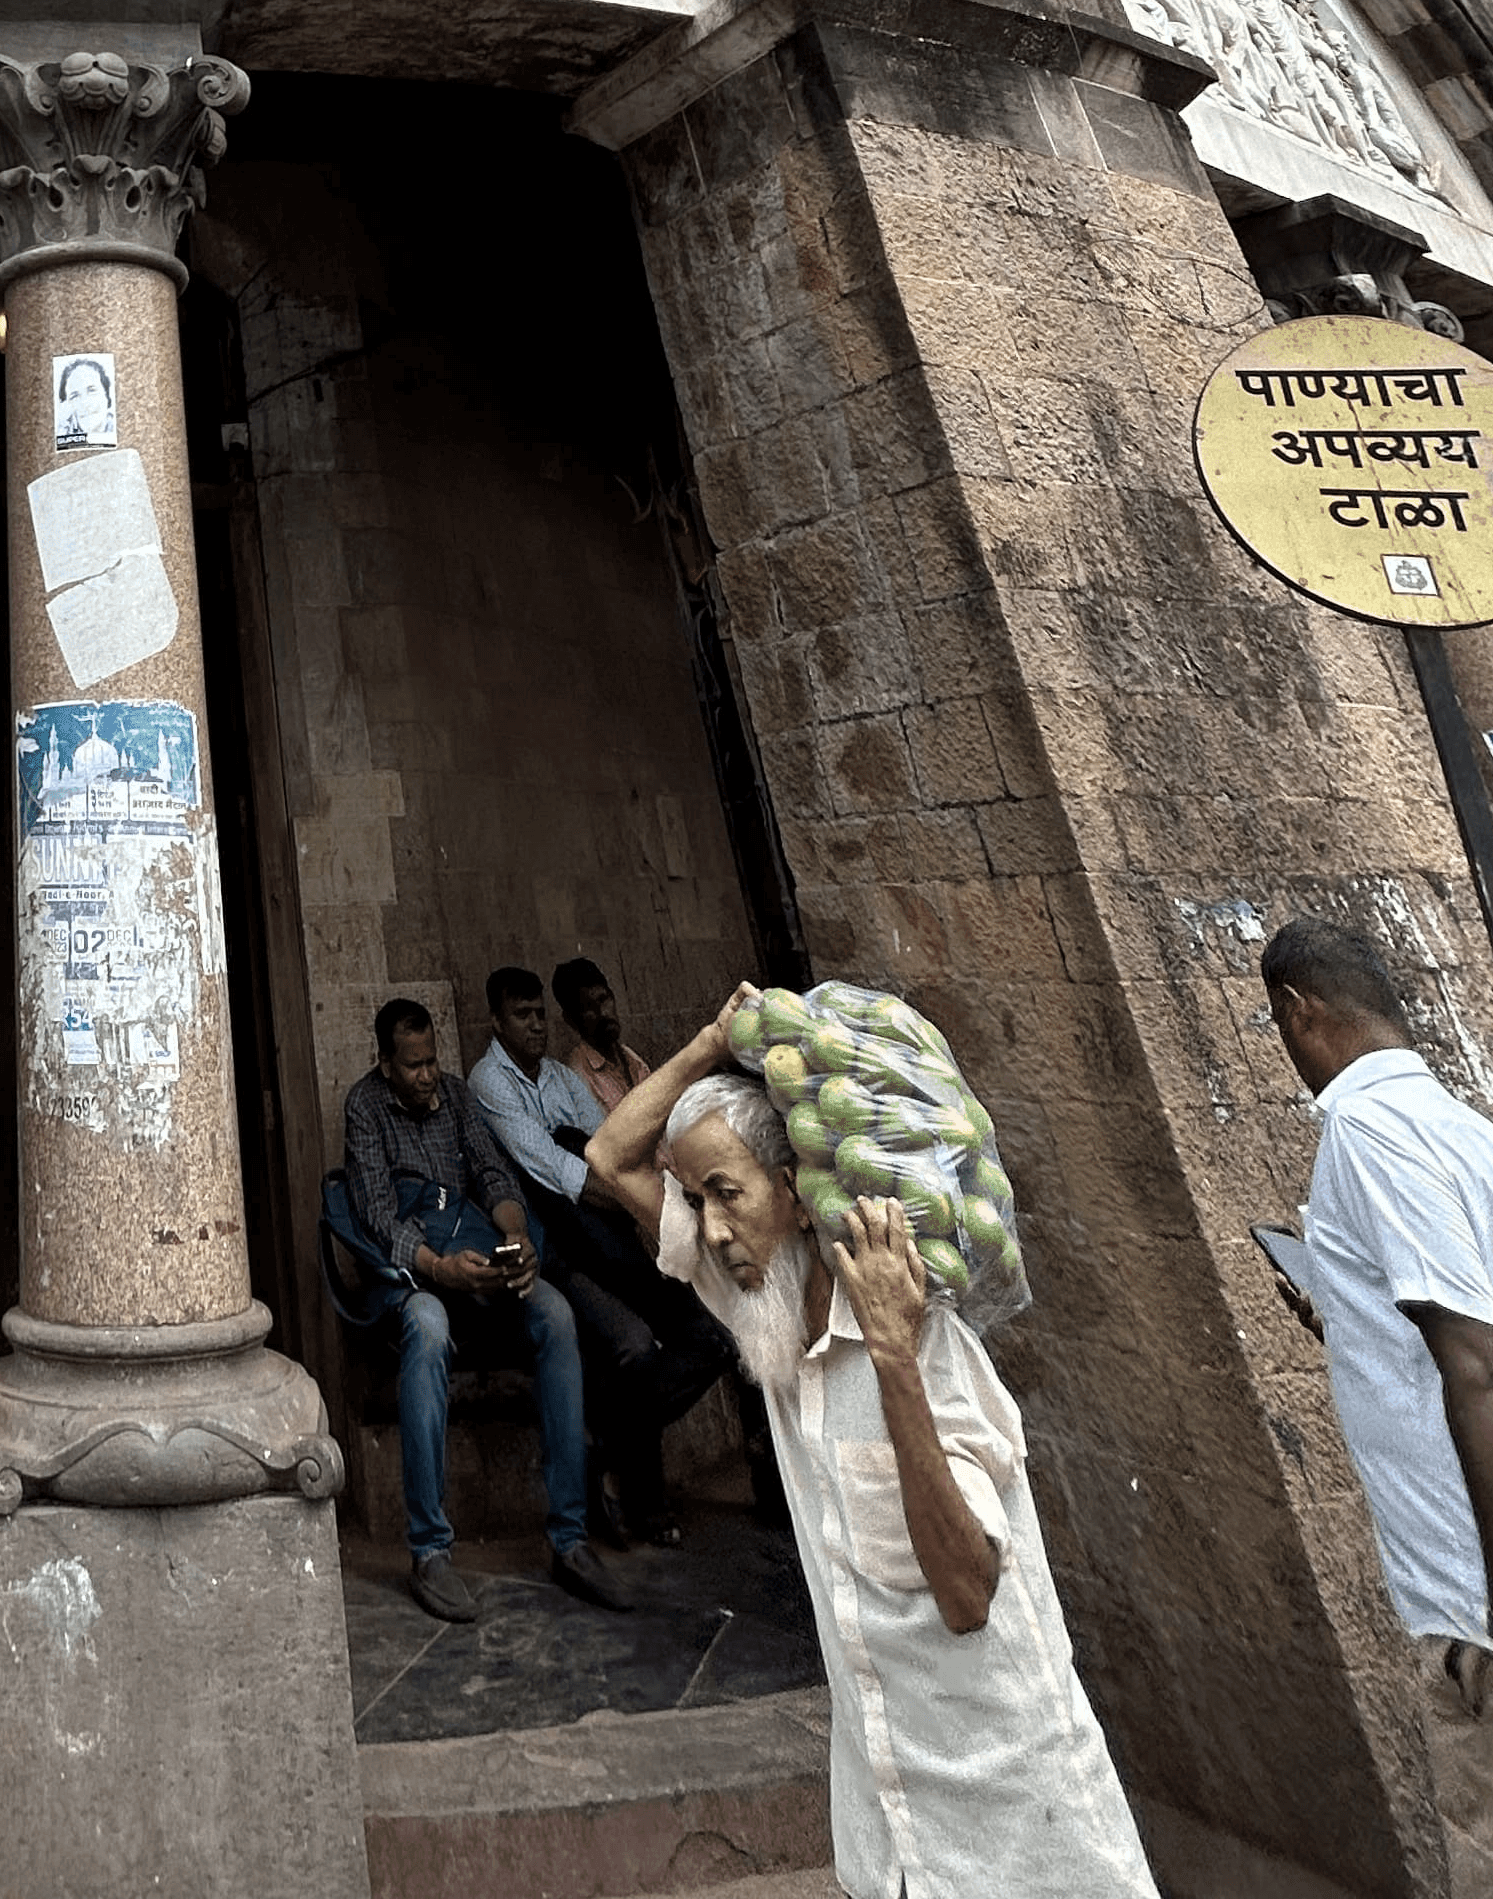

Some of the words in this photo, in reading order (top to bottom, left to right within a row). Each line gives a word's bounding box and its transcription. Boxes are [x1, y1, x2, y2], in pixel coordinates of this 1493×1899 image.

[1235, 368, 1467, 407] पाण्याचा
[1271, 430, 1481, 469] अपव्यय
[1319, 488, 1470, 532] टाळा
